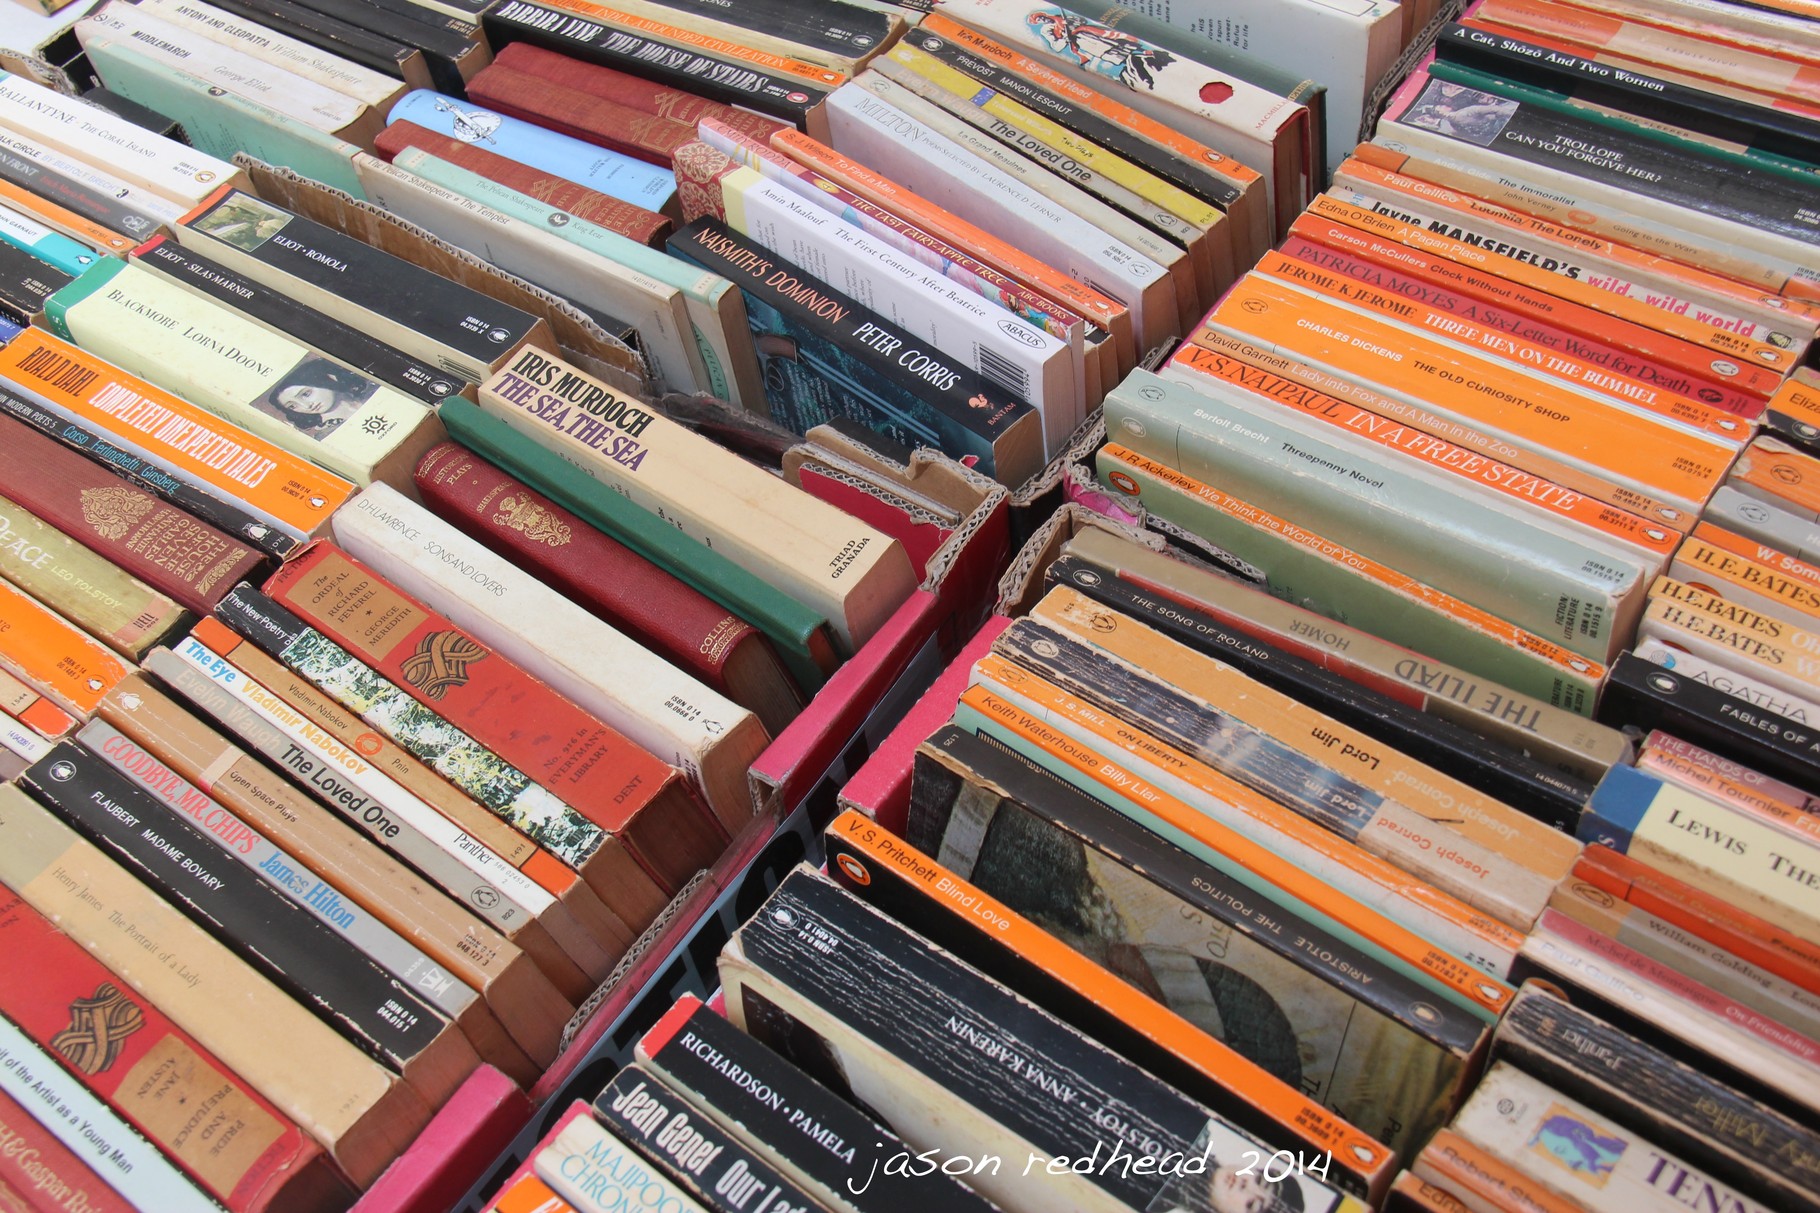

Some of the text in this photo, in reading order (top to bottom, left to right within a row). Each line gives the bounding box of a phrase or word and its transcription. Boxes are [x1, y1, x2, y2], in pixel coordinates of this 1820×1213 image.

[132, 30, 191, 59] MIDDLEMARCH
[496, 1, 767, 93] BARBARA VINE THE HOUSE OF STAIRS
[1454, 28, 1665, 92] A Cat, Shōzō And Two Women
[989, 118, 1092, 183] The Loved One
[1505, 131, 1662, 184] CAN YOU FORGIVE HER?
[1554, 133, 1624, 162] TROLLOPE
[367, 158, 510, 226] The Pelican Shakespeare The Tempest
[272, 234, 349, 272] ELIOT ROMOLA
[761, 186, 986, 318] Amin Maalouf The First Century After Beatrice
[1317, 200, 1486, 263] Edna O'Brien A Pagan Place
[154, 247, 255, 300] ELIOT SILAS MARNER
[1328, 228, 1554, 313] Carson McCullers Clock Without Hands
[107, 289, 274, 378] BLACKMORE LORNA DOONE
[693, 227, 963, 392] NAISMITH'S DOMINION PETER CORRIS
[1003, 320, 1041, 348] ABACUS
[1275, 261, 1657, 405] JEROME K. JEROME THREE MEN ON THE BUMMEL
[1296, 245, 1692, 395] PATRICIA MOYES A Six-Letter Word for Death
[512, 352, 655, 437] IRIS MURDOCH
[1296, 318, 1571, 424] CHARLES DICKENS THE OLD CURIOSITY SHOP
[16, 346, 277, 489] ROALD DAHL COMPLETELY UNEXPECTED TALES
[491, 373, 650, 471] THE SEA, THE SEA
[1193, 408, 1384, 489] Bertolt Brecht Threepenny Novel
[1225, 362, 1346, 420] NAIPAUL
[1345, 410, 1389, 434] IN
[1380, 427, 1403, 446] A
[1402, 434, 1487, 474] FREE
[1482, 464, 1582, 511] STATE
[312, 571, 350, 604] ORDEAL
[313, 575, 329, 588] The
[829, 540, 856, 568] TRIAD
[831, 537, 871, 579] GRANADA
[327, 581, 369, 618] RICHARD
[337, 590, 377, 623] FEVEREL
[364, 605, 400, 637] GEORGE
[368, 608, 412, 646] MEREDITH
[1131, 594, 1269, 660] THE SONG OF ROLAND
[1563, 599, 1580, 640] LITERATURE
[185, 642, 369, 775] The Eye Vladimir Nabokov
[1692, 670, 1808, 724] AGATHA
[1720, 704, 1808, 745] FABLES OF
[982, 696, 1161, 803] Keith Waterhouse Billy Liar
[280, 744, 400, 838] The Loved One
[90, 791, 225, 892] FLAUBERT MADAME BOVARY
[103, 735, 356, 930] GOODBYE, MR. CHIPS James Hilton
[1667, 809, 1748, 855] LEWIS
[849, 820, 1010, 931] V. S. Pritchett Blind Love
[1191, 877, 1373, 984] ARISTOTLE THE POLITICS
[612, 1081, 725, 1178] Jean Genet
[680, 1031, 857, 1164] RICHARDSON PAMELA
